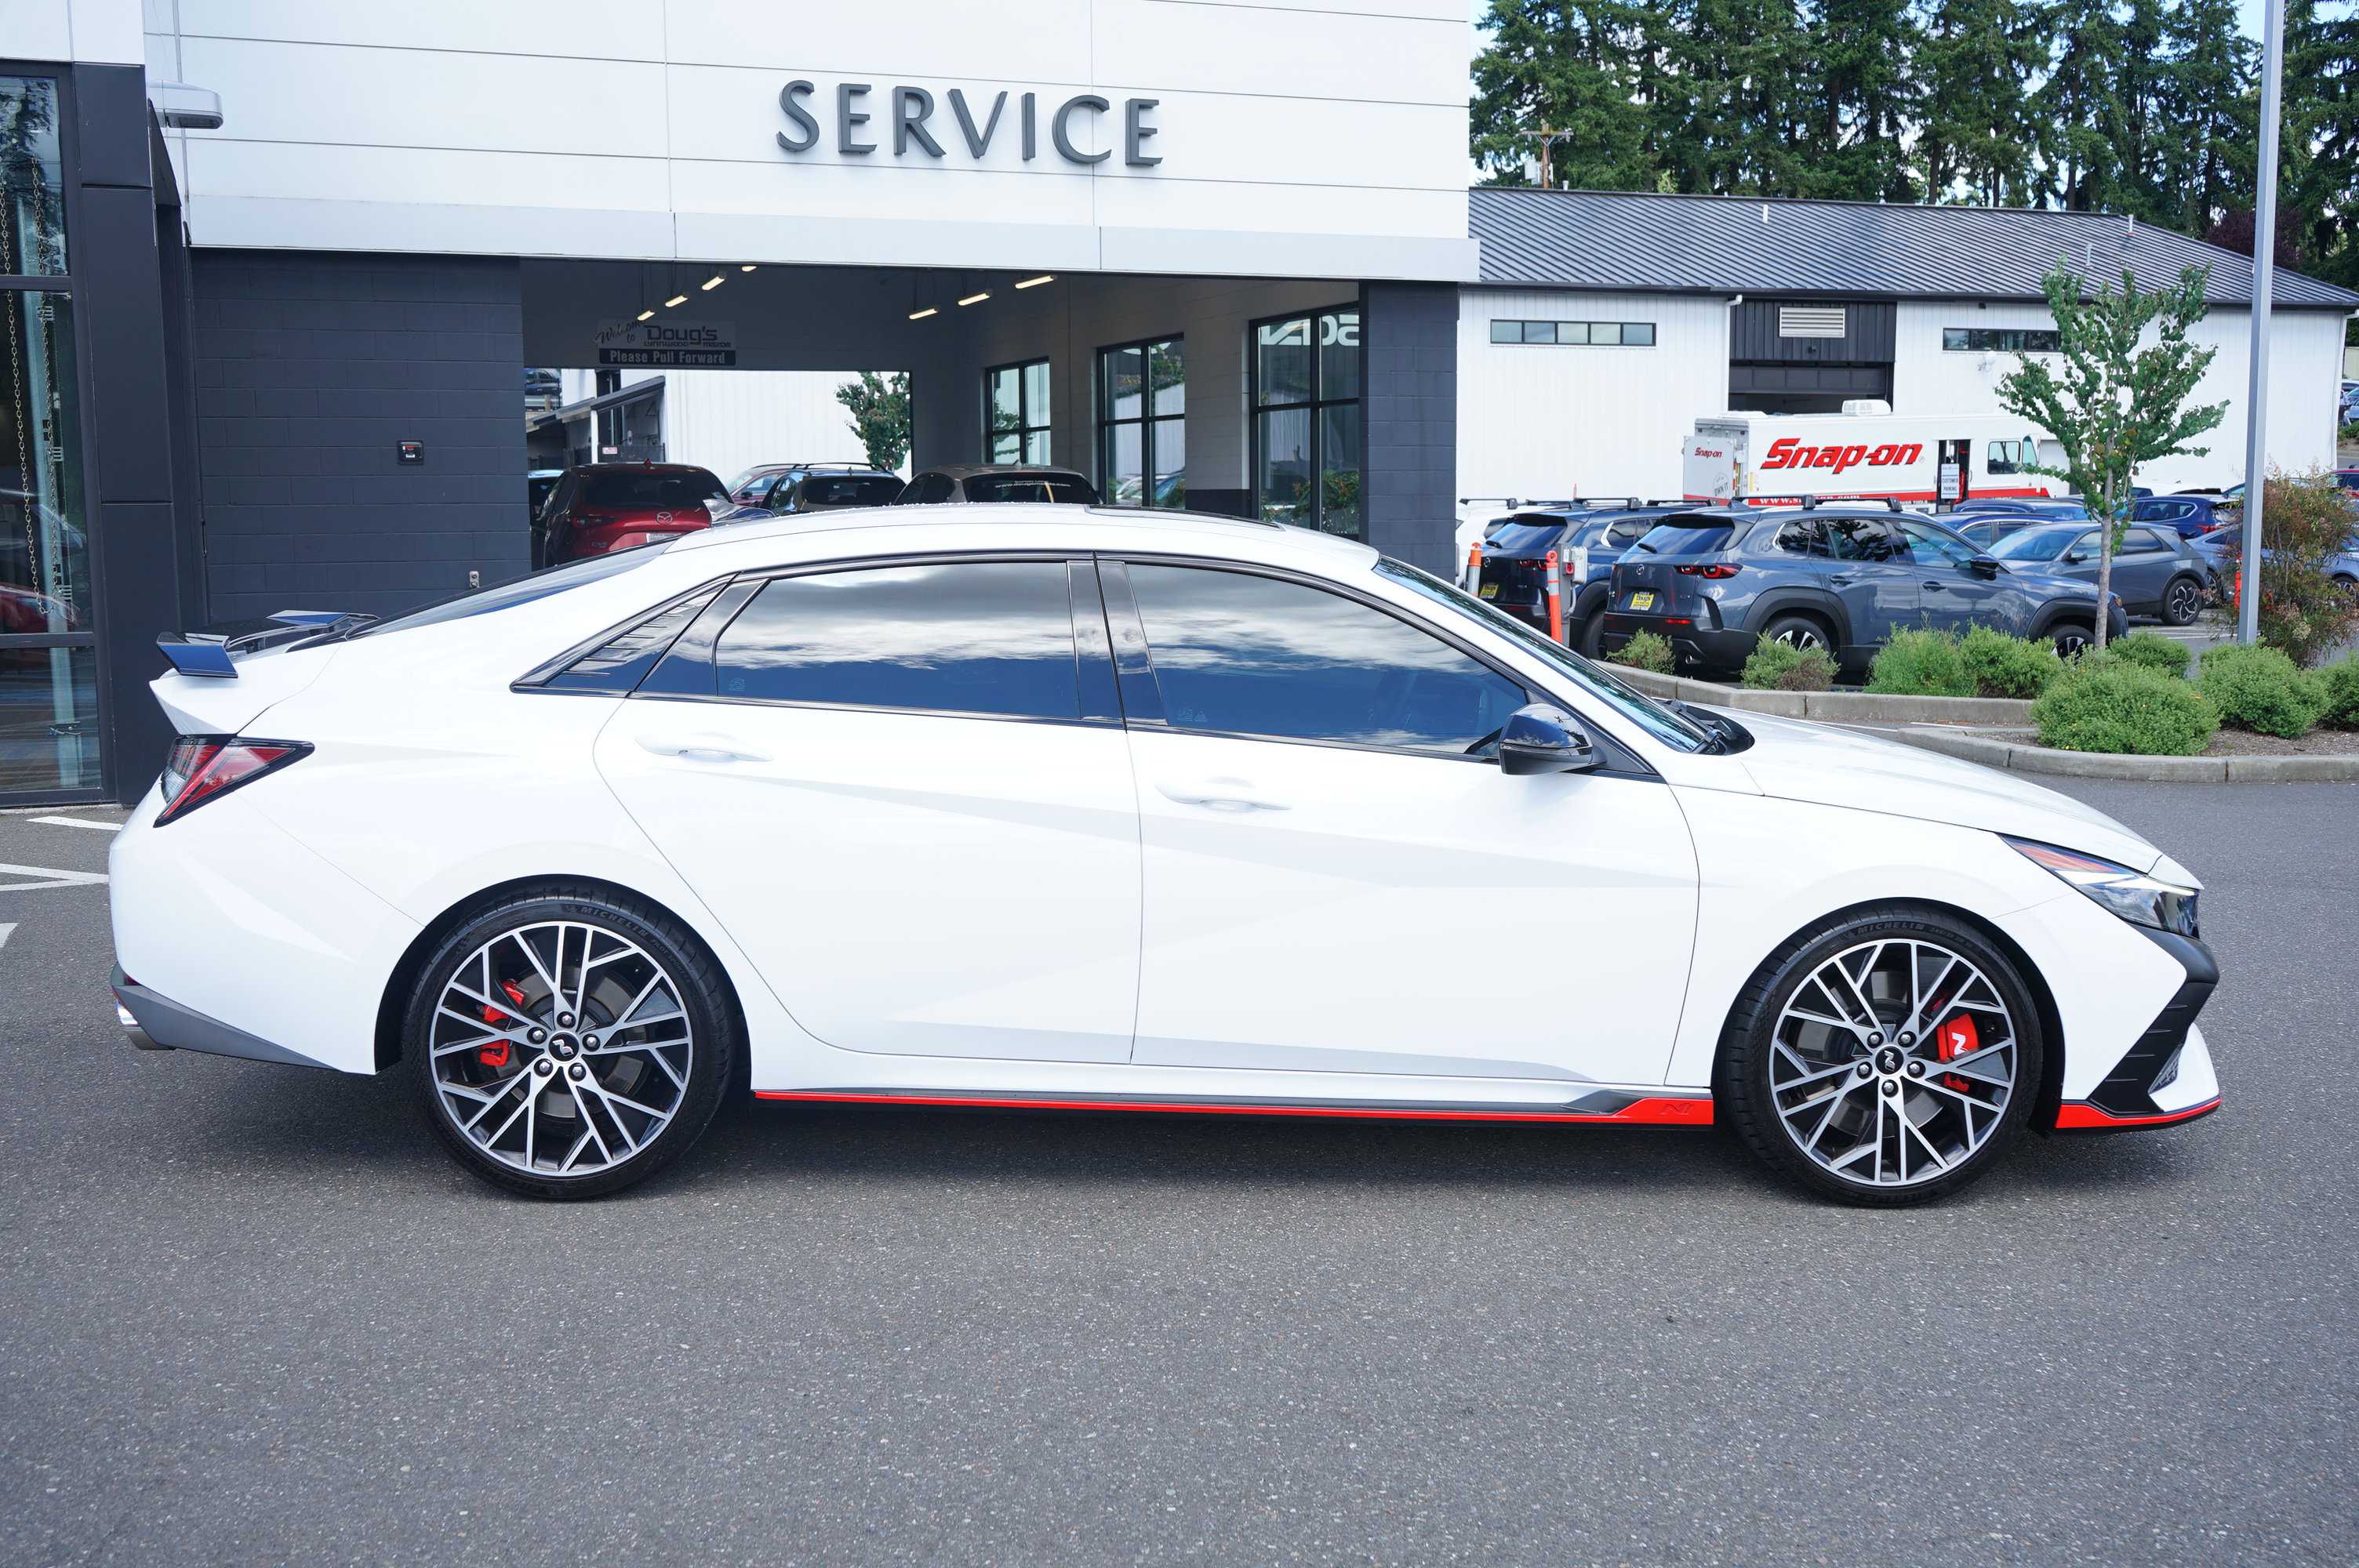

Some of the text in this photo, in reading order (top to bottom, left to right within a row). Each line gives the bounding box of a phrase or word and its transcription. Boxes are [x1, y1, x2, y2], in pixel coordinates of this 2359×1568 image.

[776, 79, 1163, 166] SERVICE
[595, 320, 646, 344] Welcome
[627, 332, 636, 343] to
[644, 325, 718, 345] Doug's
[610, 350, 725, 364] Please Pull Forward
[1695, 448, 1722, 459] Snap-on
[1760, 438, 1923, 474] Snap-on
[580, 906, 649, 938] MICHELIN
[650, 938, 669, 955] PILOT
[1858, 922, 1926, 935] MICHELIN
